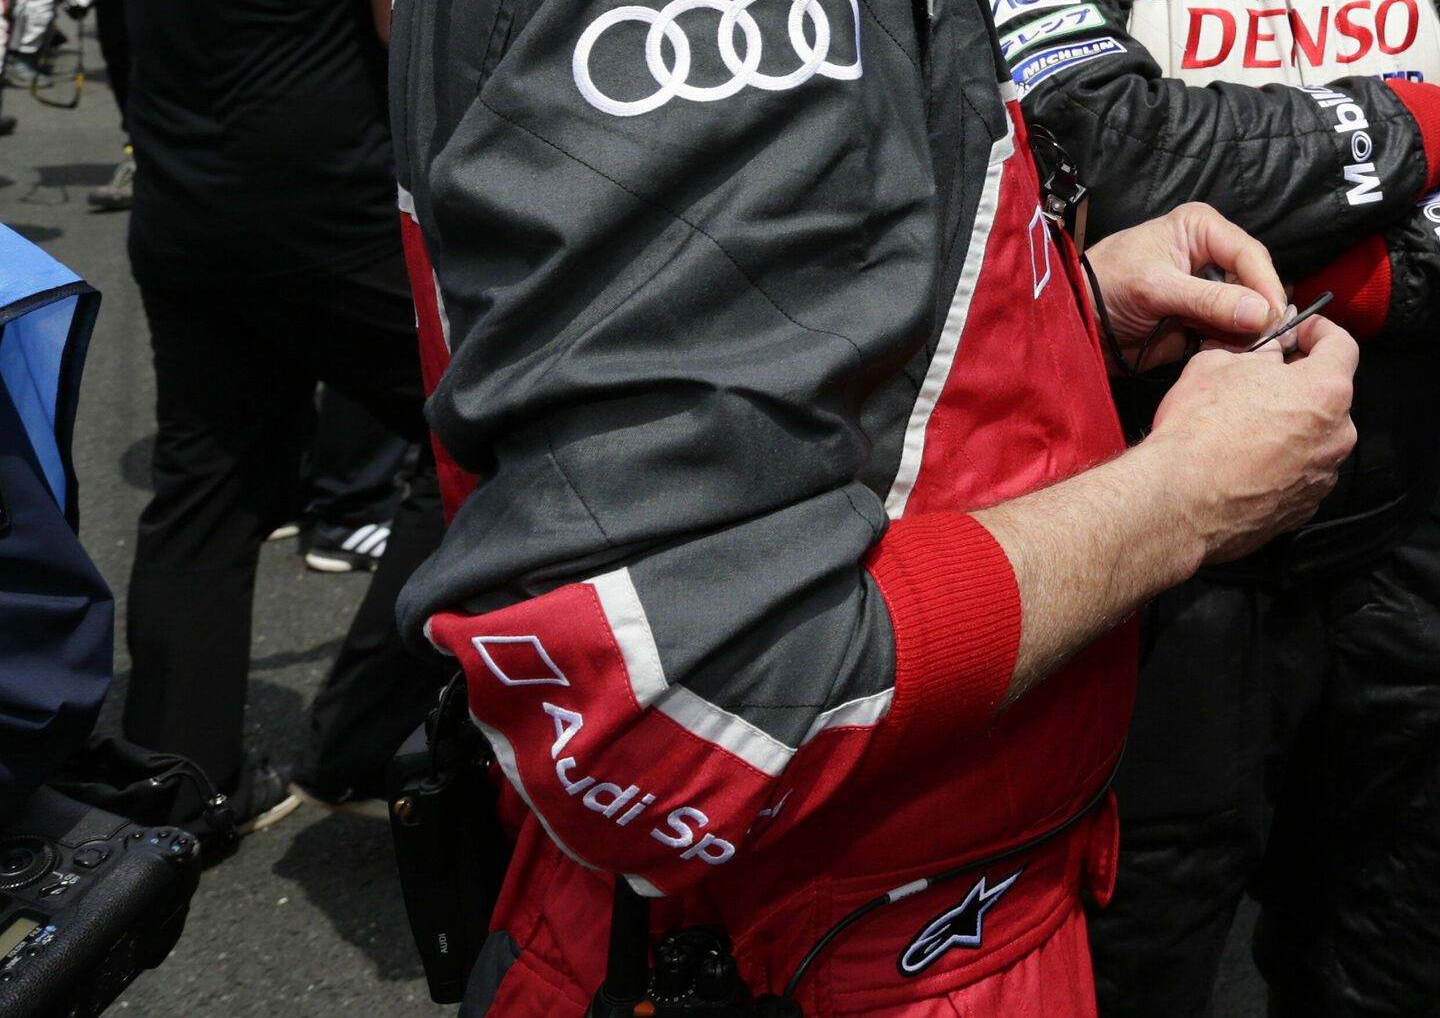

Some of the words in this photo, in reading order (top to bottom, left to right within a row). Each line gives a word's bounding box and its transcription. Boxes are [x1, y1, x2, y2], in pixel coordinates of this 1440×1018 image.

[1021, 39, 1116, 81] MICHELIN
[1311, 91, 1384, 207] Mobil
[542, 701, 657, 827] Audi
[438, 933, 449, 954] AUDI
